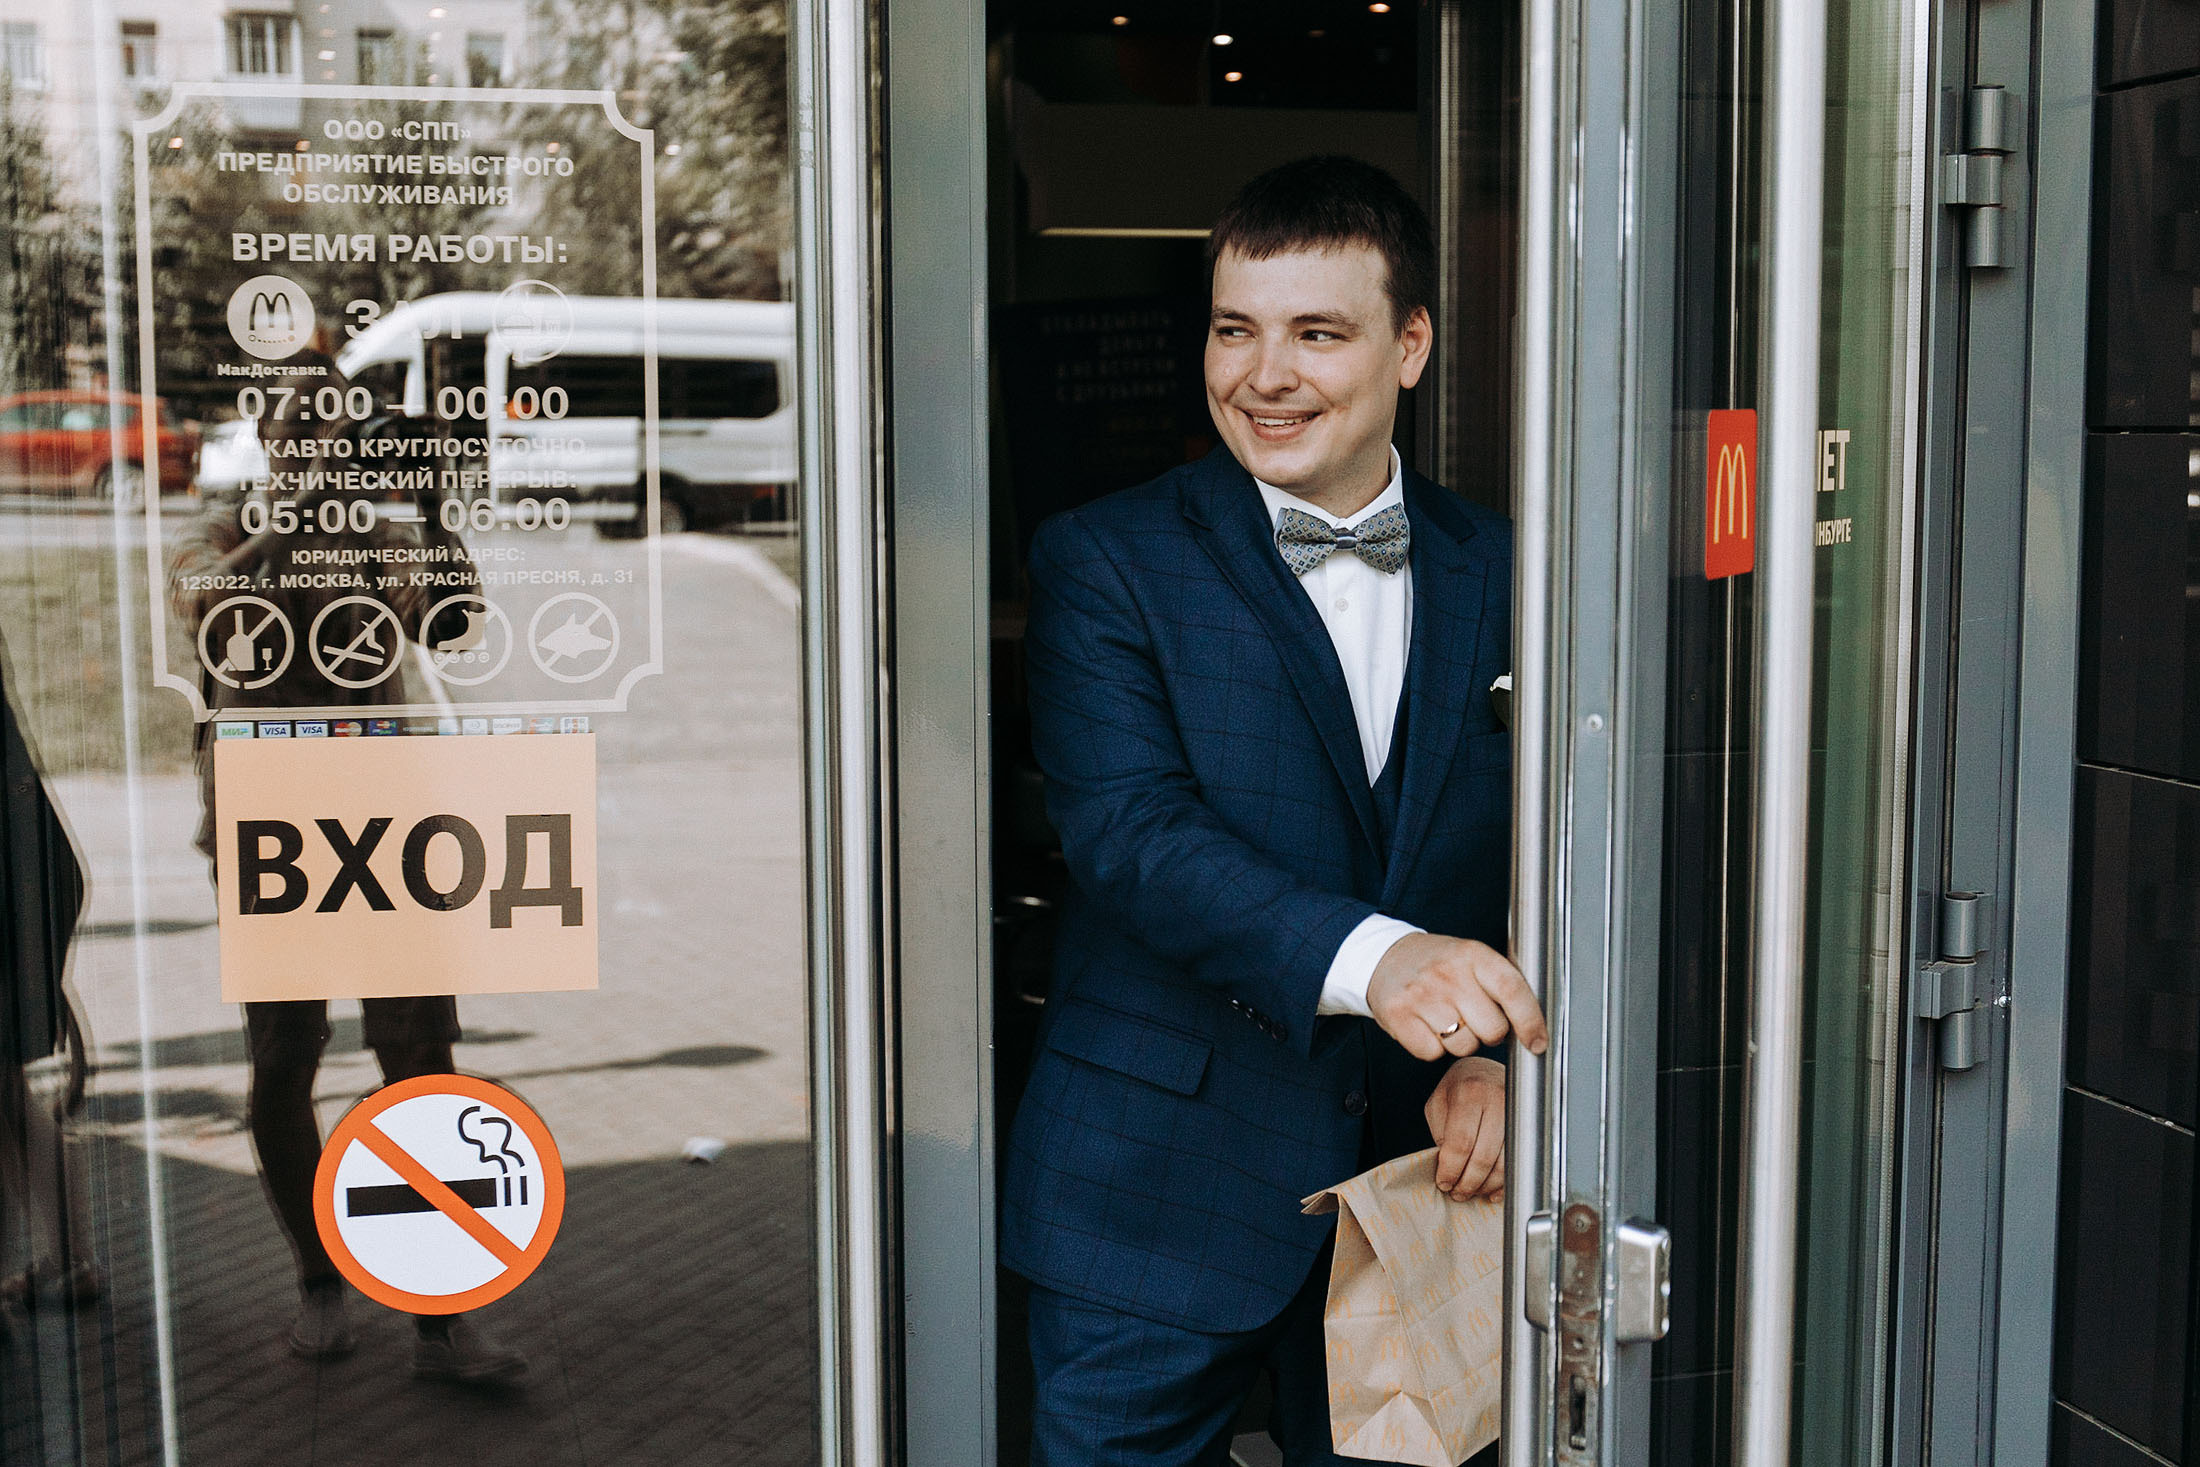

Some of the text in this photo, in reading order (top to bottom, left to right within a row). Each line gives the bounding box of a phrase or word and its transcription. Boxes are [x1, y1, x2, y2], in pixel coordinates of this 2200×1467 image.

[323, 120, 471, 141] ООО «СПП»
[218, 152, 574, 177] ПРЕДПРИЯТИЕ БЫСТРОГО
[283, 183, 513, 206] ОБСЛУЖИВАНИЯ
[231, 233, 569, 264] ВРЕМЯ РАБОТЫ:
[217, 363, 327, 377] МакДоставка
[237, 387, 374, 421] 07:00
[436, 386, 570, 421] 00:00
[233, 437, 586, 458] КАВТО КРУГЛОСУТОЧНО
[441, 470, 577, 490] ПЕРЕРЫВ:
[241, 500, 376, 535] 05:00
[439, 498, 571, 532] 06:00
[291, 545, 526, 566] ЮРИДИЧЕСКИЙ АДРЕС:
[180, 569, 633, 592] 123022, г. МОСКВА, ул. КРАСНАЯ ПРЕСНЯ, д. 31
[264, 727, 288, 736] VISA
[300, 726, 324, 735] VISA
[236, 813, 583, 929] ВХОД
